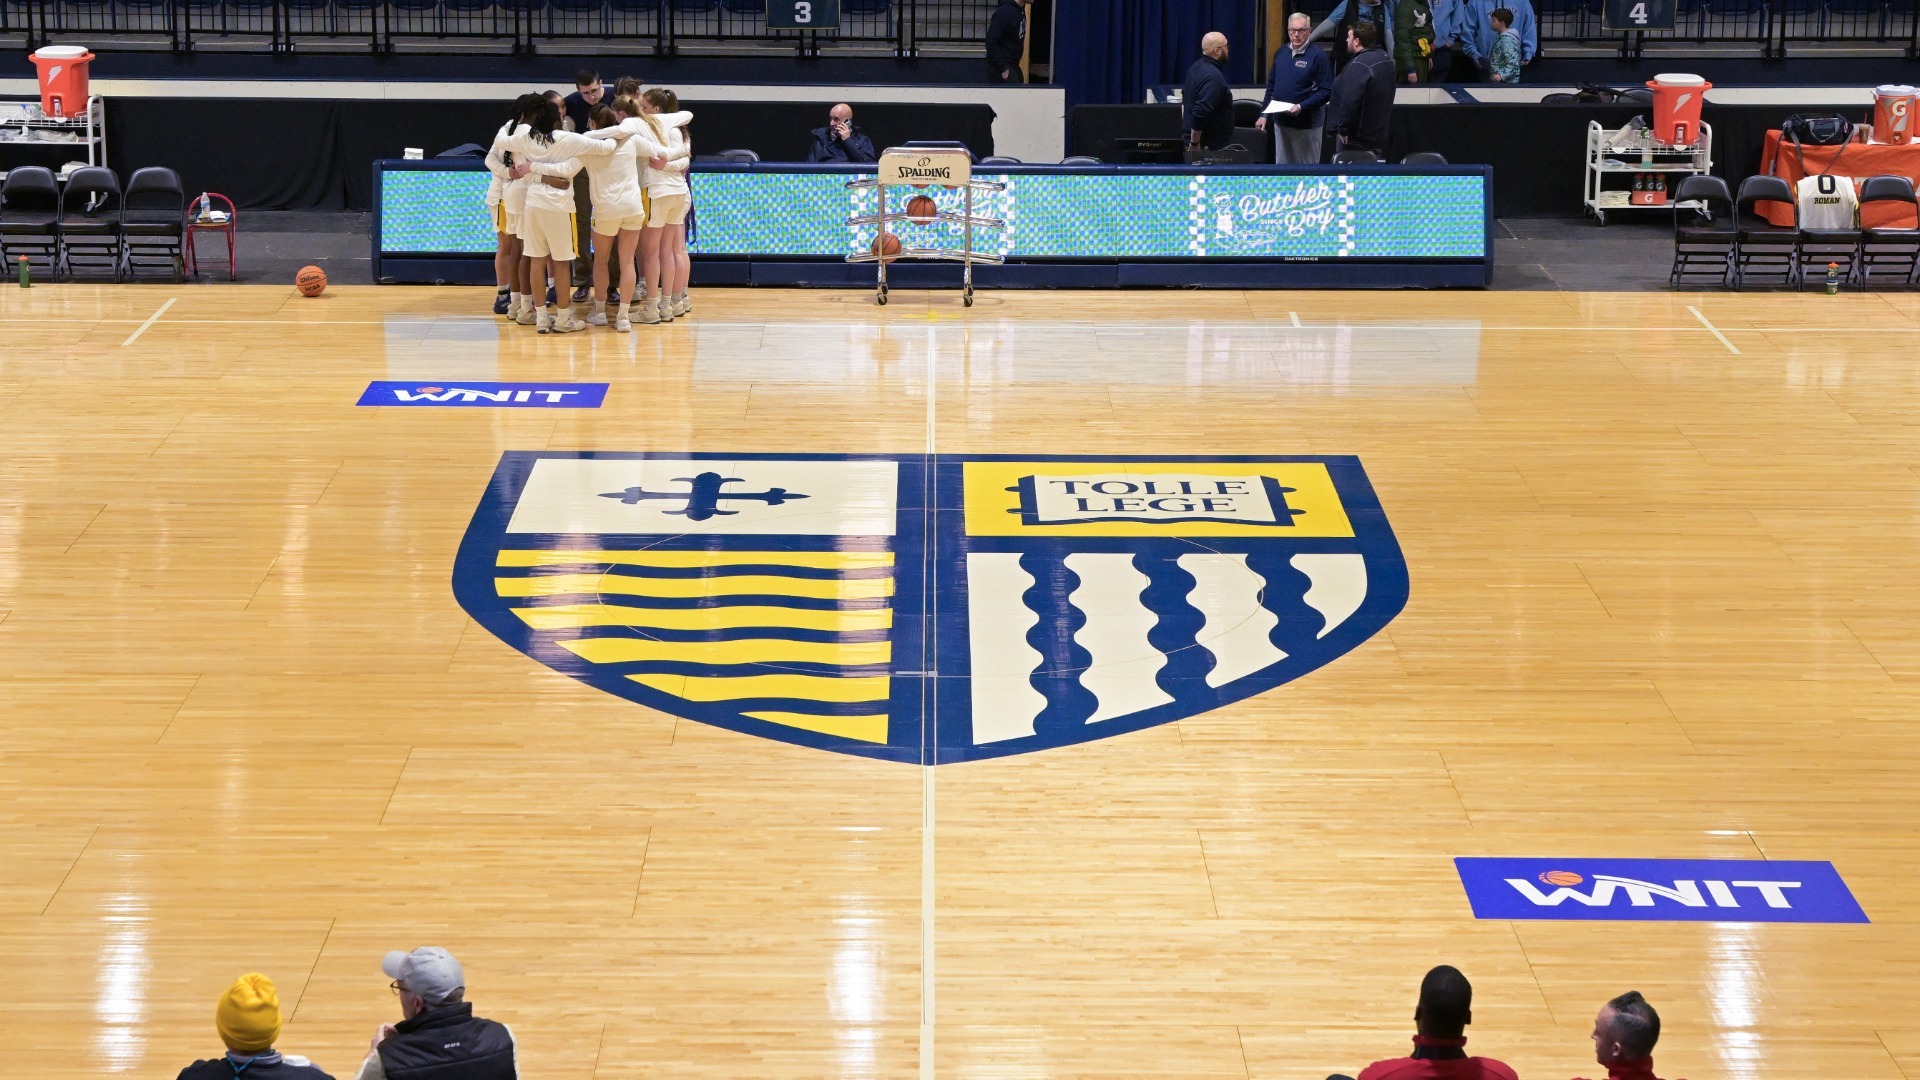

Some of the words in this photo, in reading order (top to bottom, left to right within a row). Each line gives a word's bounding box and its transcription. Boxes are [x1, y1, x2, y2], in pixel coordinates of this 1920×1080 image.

[794, 2, 811, 23] 3
[1629, 3, 1648, 24] 4
[1892, 101, 1906, 116] G
[898, 166, 950, 178] SPALDING
[1239, 180, 1333, 221] Butcher
[1644, 194, 1654, 202] G
[1284, 208, 1335, 236] Boy
[300, 275, 320, 283] Wilson
[393, 388, 580, 403] WNIT
[1049, 481, 1250, 495] TOLLE
[1074, 498, 1237, 512] LEGE
[1503, 874, 1802, 908] WNIT
